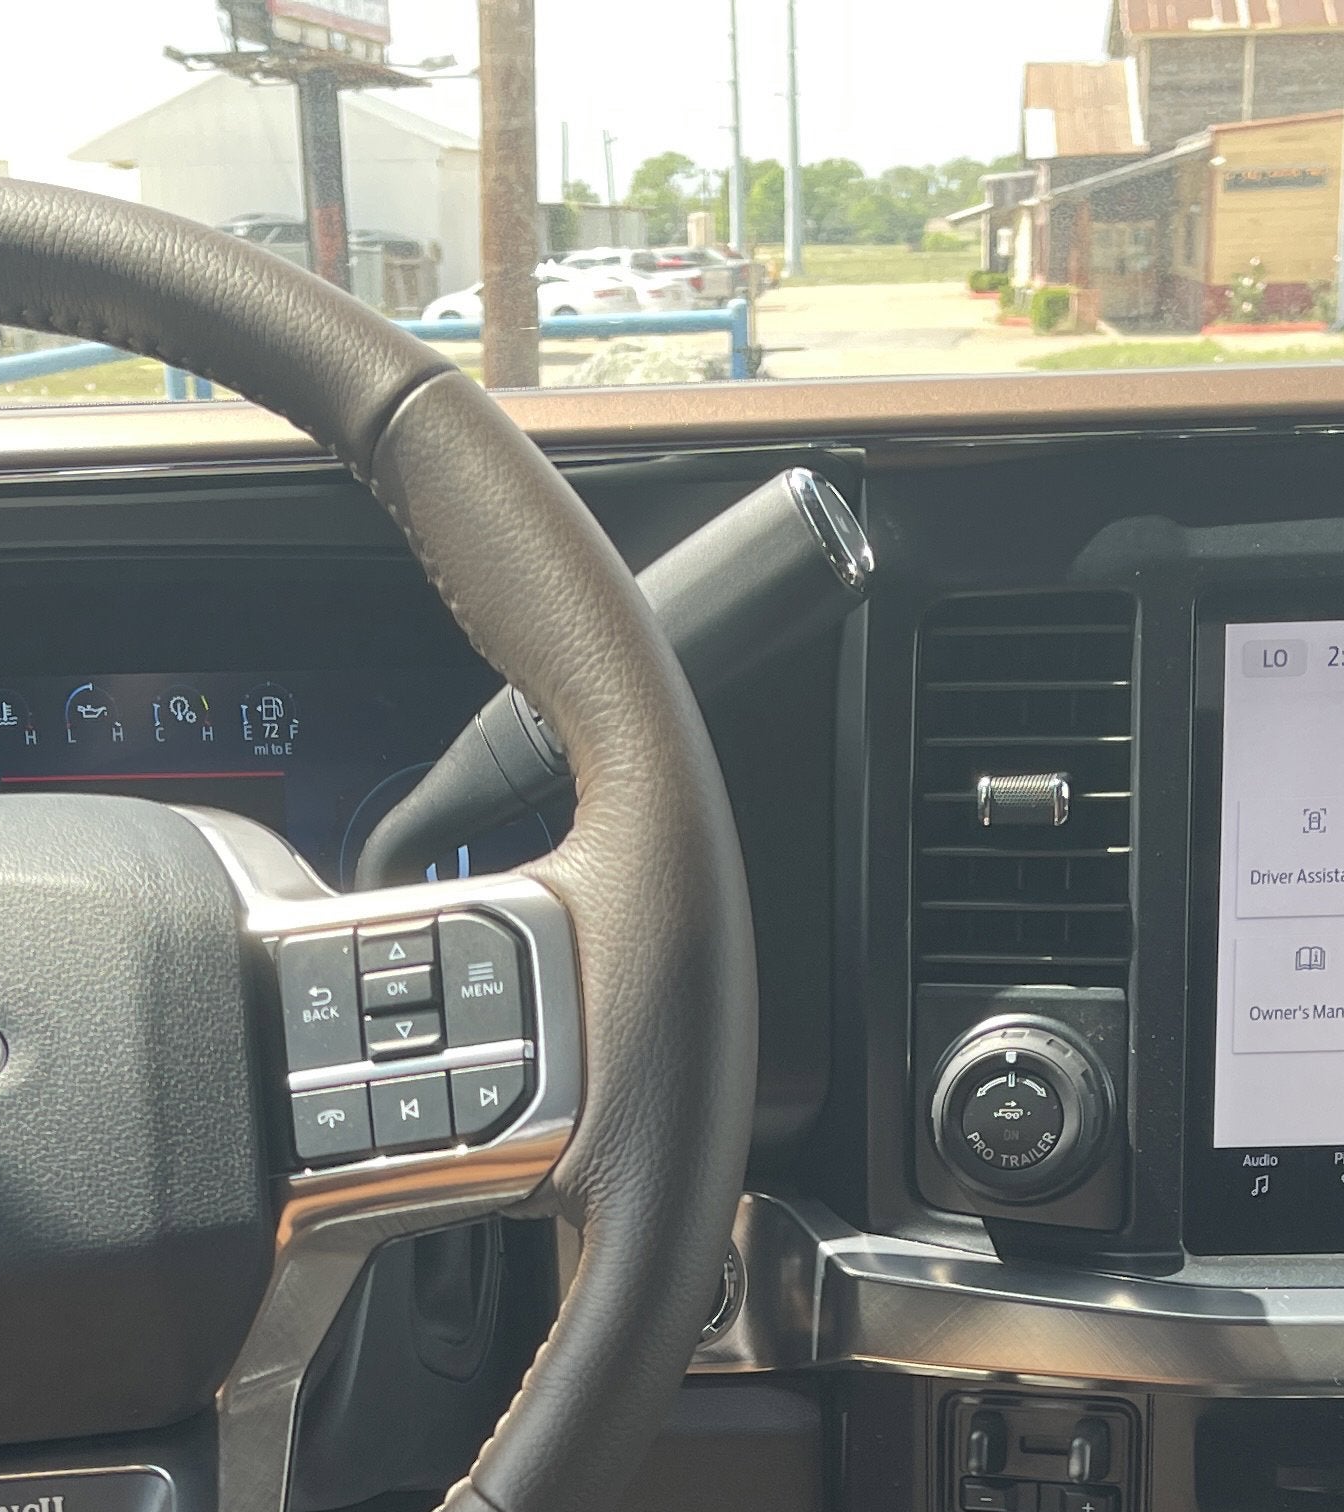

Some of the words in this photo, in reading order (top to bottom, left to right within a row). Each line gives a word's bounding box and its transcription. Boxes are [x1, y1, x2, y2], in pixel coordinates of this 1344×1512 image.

[1262, 650, 1288, 668] LO
[25, 730, 37, 745] H
[67, 728, 76, 743] L
[112, 727, 124, 742] H
[156, 727, 166, 742] C
[202, 726, 214, 741] H
[244, 725, 253, 741] E
[262, 723, 279, 739] 72
[290, 724, 298, 740] F
[272, 743, 284, 755] to
[285, 742, 293, 755] E
[1250, 868, 1293, 885] Driver
[387, 981, 408, 996] OK
[461, 981, 503, 999] MENU
[302, 1005, 339, 1023] BACK
[1249, 1004, 1309, 1021] Owner's
[966, 1131, 995, 1161] PRO
[1000, 1131, 1057, 1168] TRAILER
[1243, 1153, 1278, 1168] Audio
